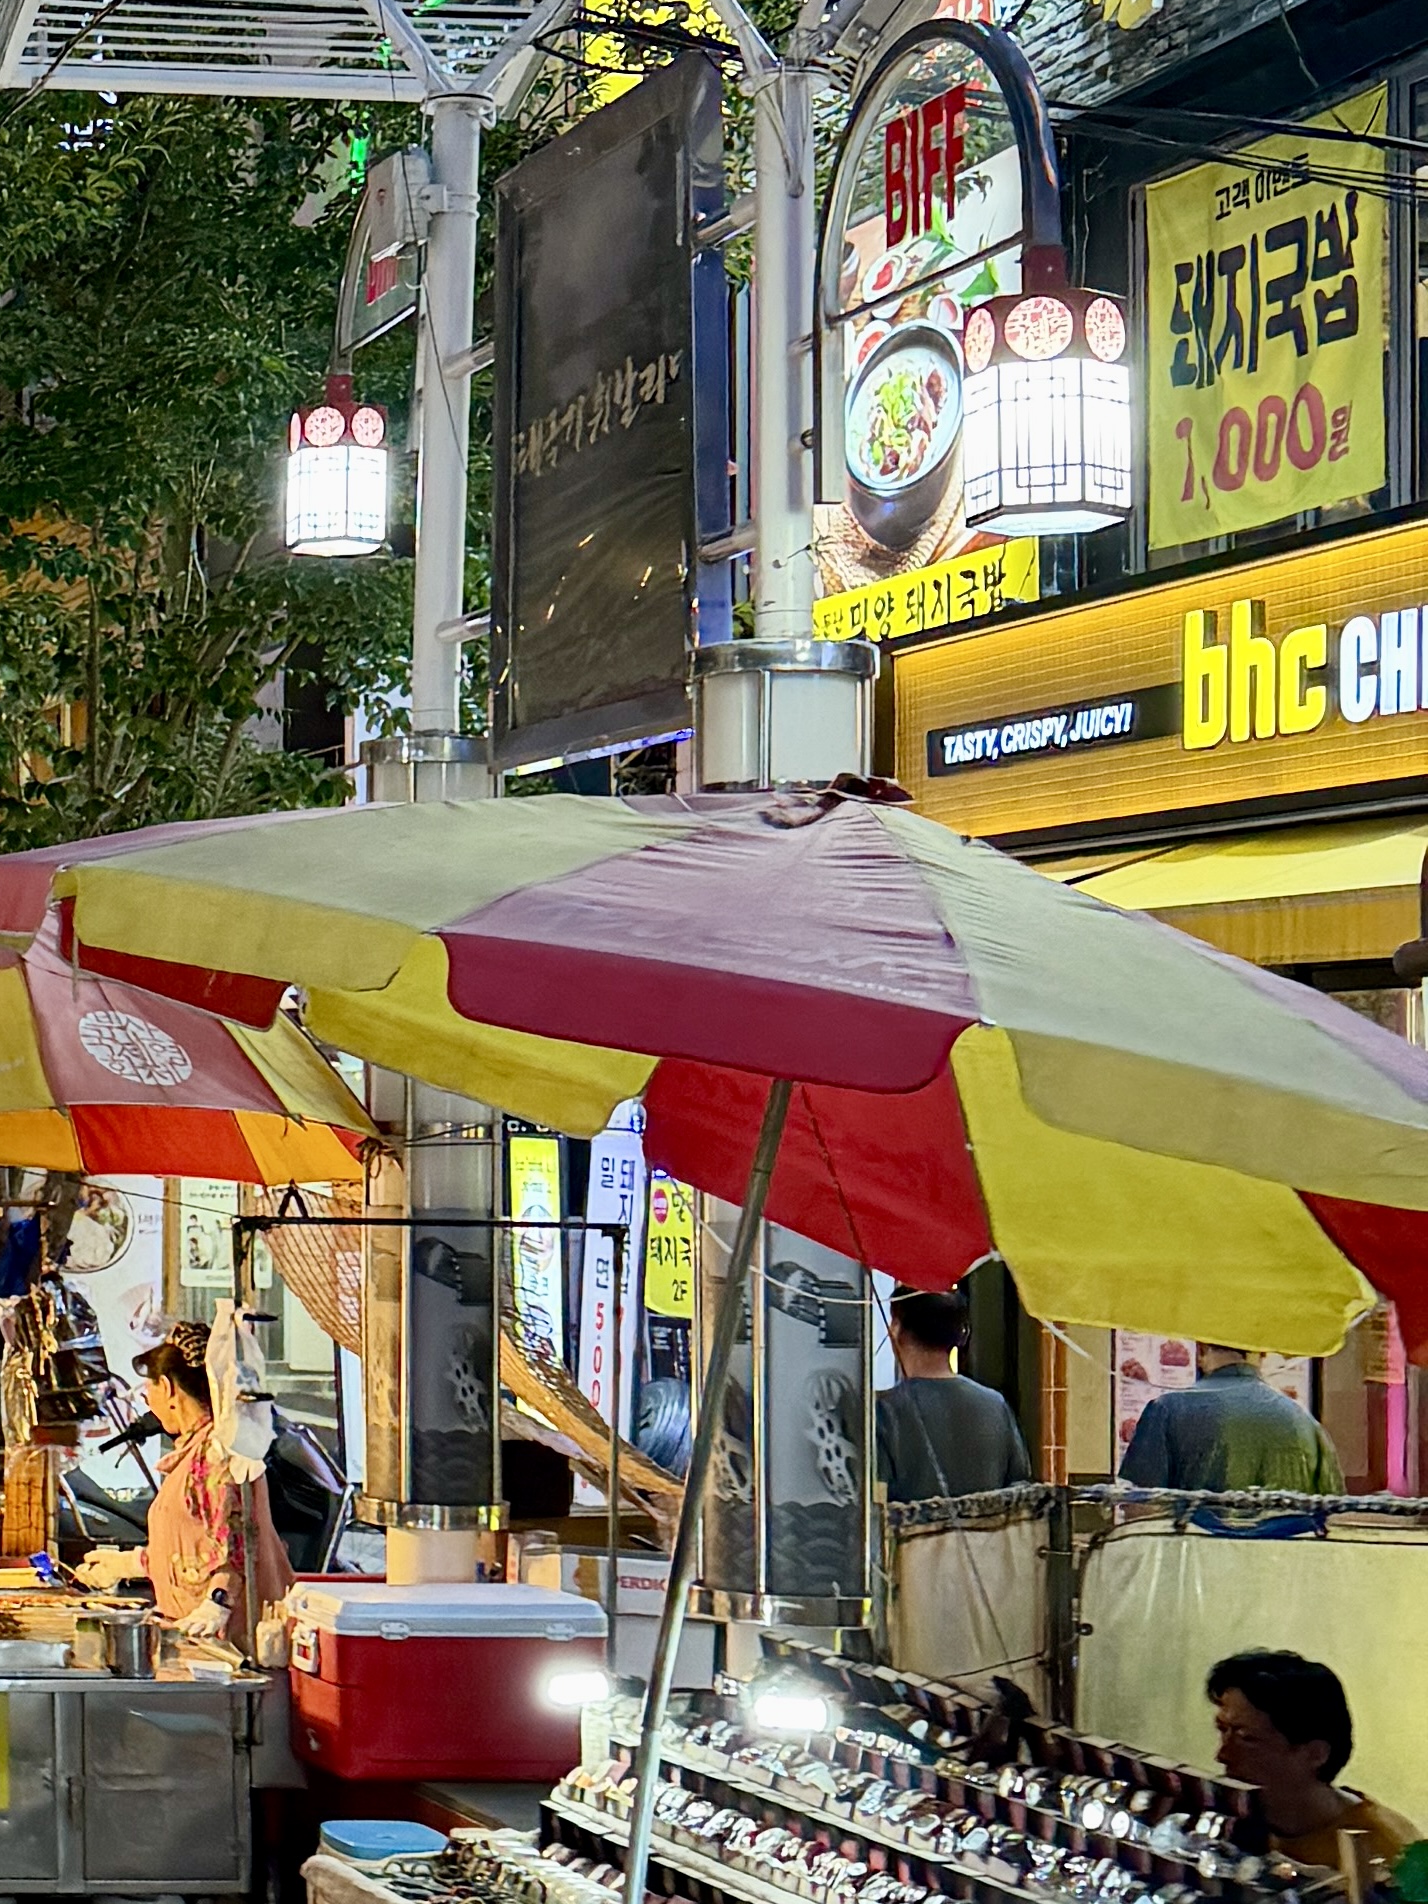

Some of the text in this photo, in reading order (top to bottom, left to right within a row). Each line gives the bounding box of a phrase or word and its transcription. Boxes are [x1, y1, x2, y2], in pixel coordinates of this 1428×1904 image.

[884, 82, 967, 249] BIFF
[1169, 190, 1359, 390] 돼지국밥
[1174, 381, 1353, 511] 1,000원
[942, 700, 1133, 765] TASTY, CRISPY, JUICY!
[1182, 598, 1428, 751] bhc CH
